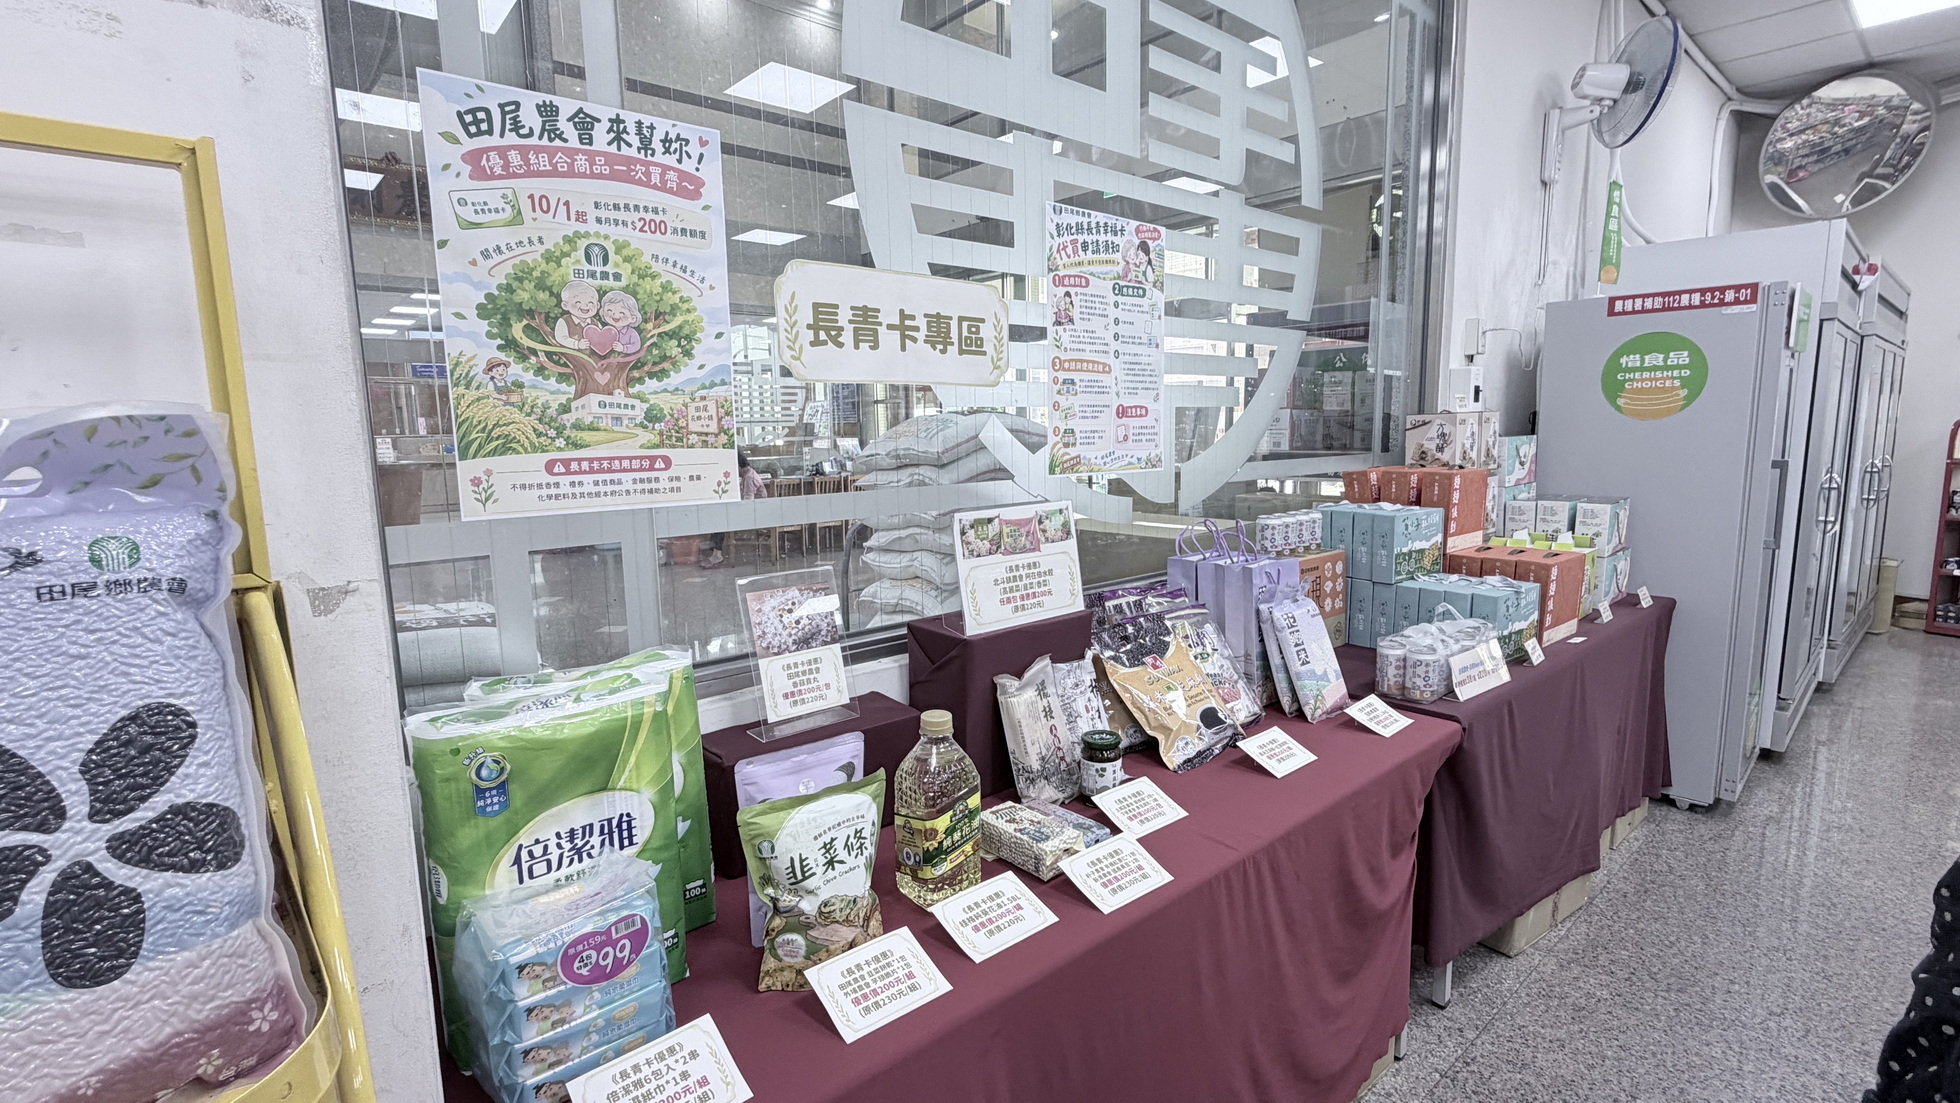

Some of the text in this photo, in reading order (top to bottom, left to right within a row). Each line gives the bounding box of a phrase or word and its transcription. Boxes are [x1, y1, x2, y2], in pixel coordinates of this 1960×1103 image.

[456, 100, 705, 172] 田尾農會來幫妳!
[528, 193, 588, 224] 10/1起
[594, 201, 667, 216] 彰化縣長青幸福卡
[595, 215, 707, 241] 每月享有$200消費額度
[1055, 221, 1126, 239] 彰化縣長青幸福卡
[479, 235, 545, 262] 關懷在地長者
[1056, 238, 1120, 260] 代買申請須知
[573, 268, 623, 283] 田尾農會
[650, 253, 706, 285] 陪伴幸福生活
[806, 301, 988, 357] 長青卡專區
[1620, 351, 1690, 368] 惜食品
[1617, 369, 1690, 380] CHERISHED
[1625, 379, 1681, 389] CHOICES
[608, 401, 636, 411] 田尾農會
[694, 404, 709, 413] 田尾
[569, 459, 650, 472] 長青卡不適用部分
[1019, 589, 1053, 602] 優惠價200元
[1011, 600, 1044, 615] (原價220元)
[781, 656, 823, 672] 《長青卡優惠》
[786, 667, 821, 681] 田尾鄉農會
[792, 677, 820, 689] 香菇貢丸
[782, 682, 831, 701] 優惠價200元/包
[789, 693, 828, 709] (原價220元)
[510, 811, 639, 886] 倍潔雅
[785, 827, 868, 886] 韭菜條
[962, 890, 1006, 914] 《長青卡優惠》
[984, 914, 1026, 939] (原價220元)
[599, 939, 632, 974] 99
[840, 949, 894, 979] 《長青卡優惠》
[838, 974, 866, 992] 田尾農會
[851, 970, 916, 1008] 優惠價200元/組
[858, 981, 922, 1018] (原價230元/組)
[612, 1041, 684, 1086] 《長青卡優惠》
